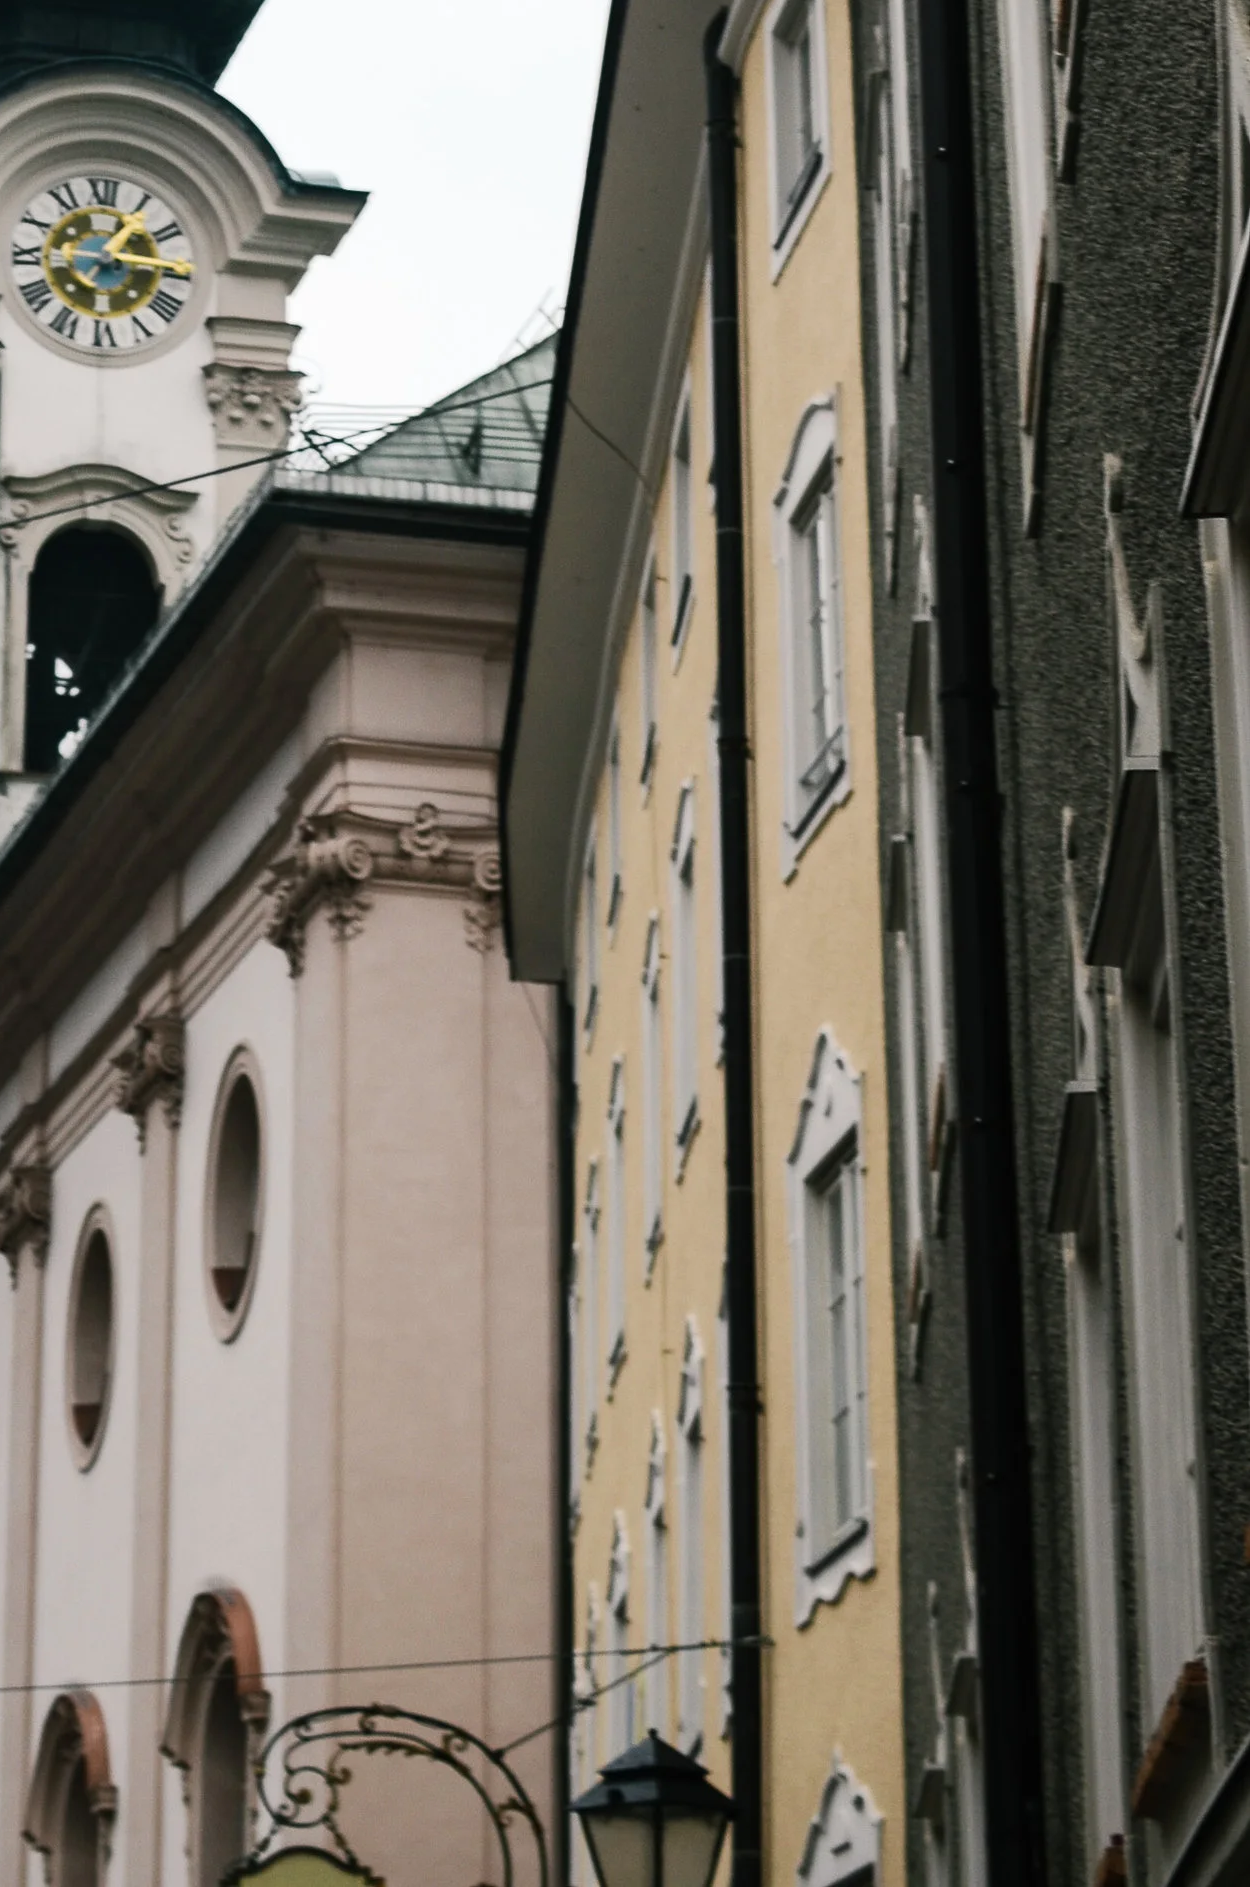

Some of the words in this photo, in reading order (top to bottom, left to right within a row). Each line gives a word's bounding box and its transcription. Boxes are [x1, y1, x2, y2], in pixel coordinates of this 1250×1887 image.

[87, 178, 121, 207] XII
[153, 222, 184, 243] II
[18, 278, 53, 313] VIII
[148, 289, 185, 324] IIII
[49, 306, 79, 340] VII
[92, 320, 118, 347] VI
